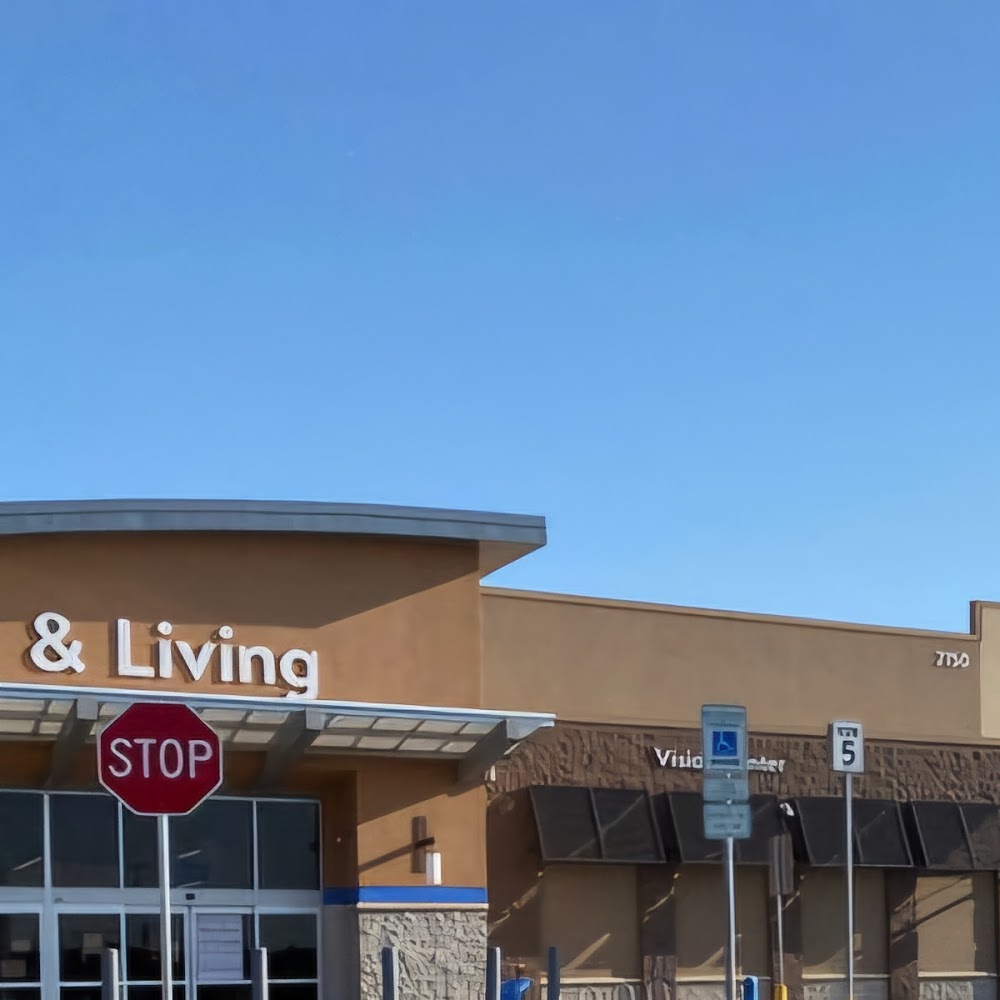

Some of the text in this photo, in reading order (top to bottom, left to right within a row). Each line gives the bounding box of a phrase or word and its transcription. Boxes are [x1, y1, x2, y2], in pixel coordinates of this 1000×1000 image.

[29, 611, 319, 700] & Living
[108, 737, 213, 779] STOP
[842, 740, 856, 766] 5
